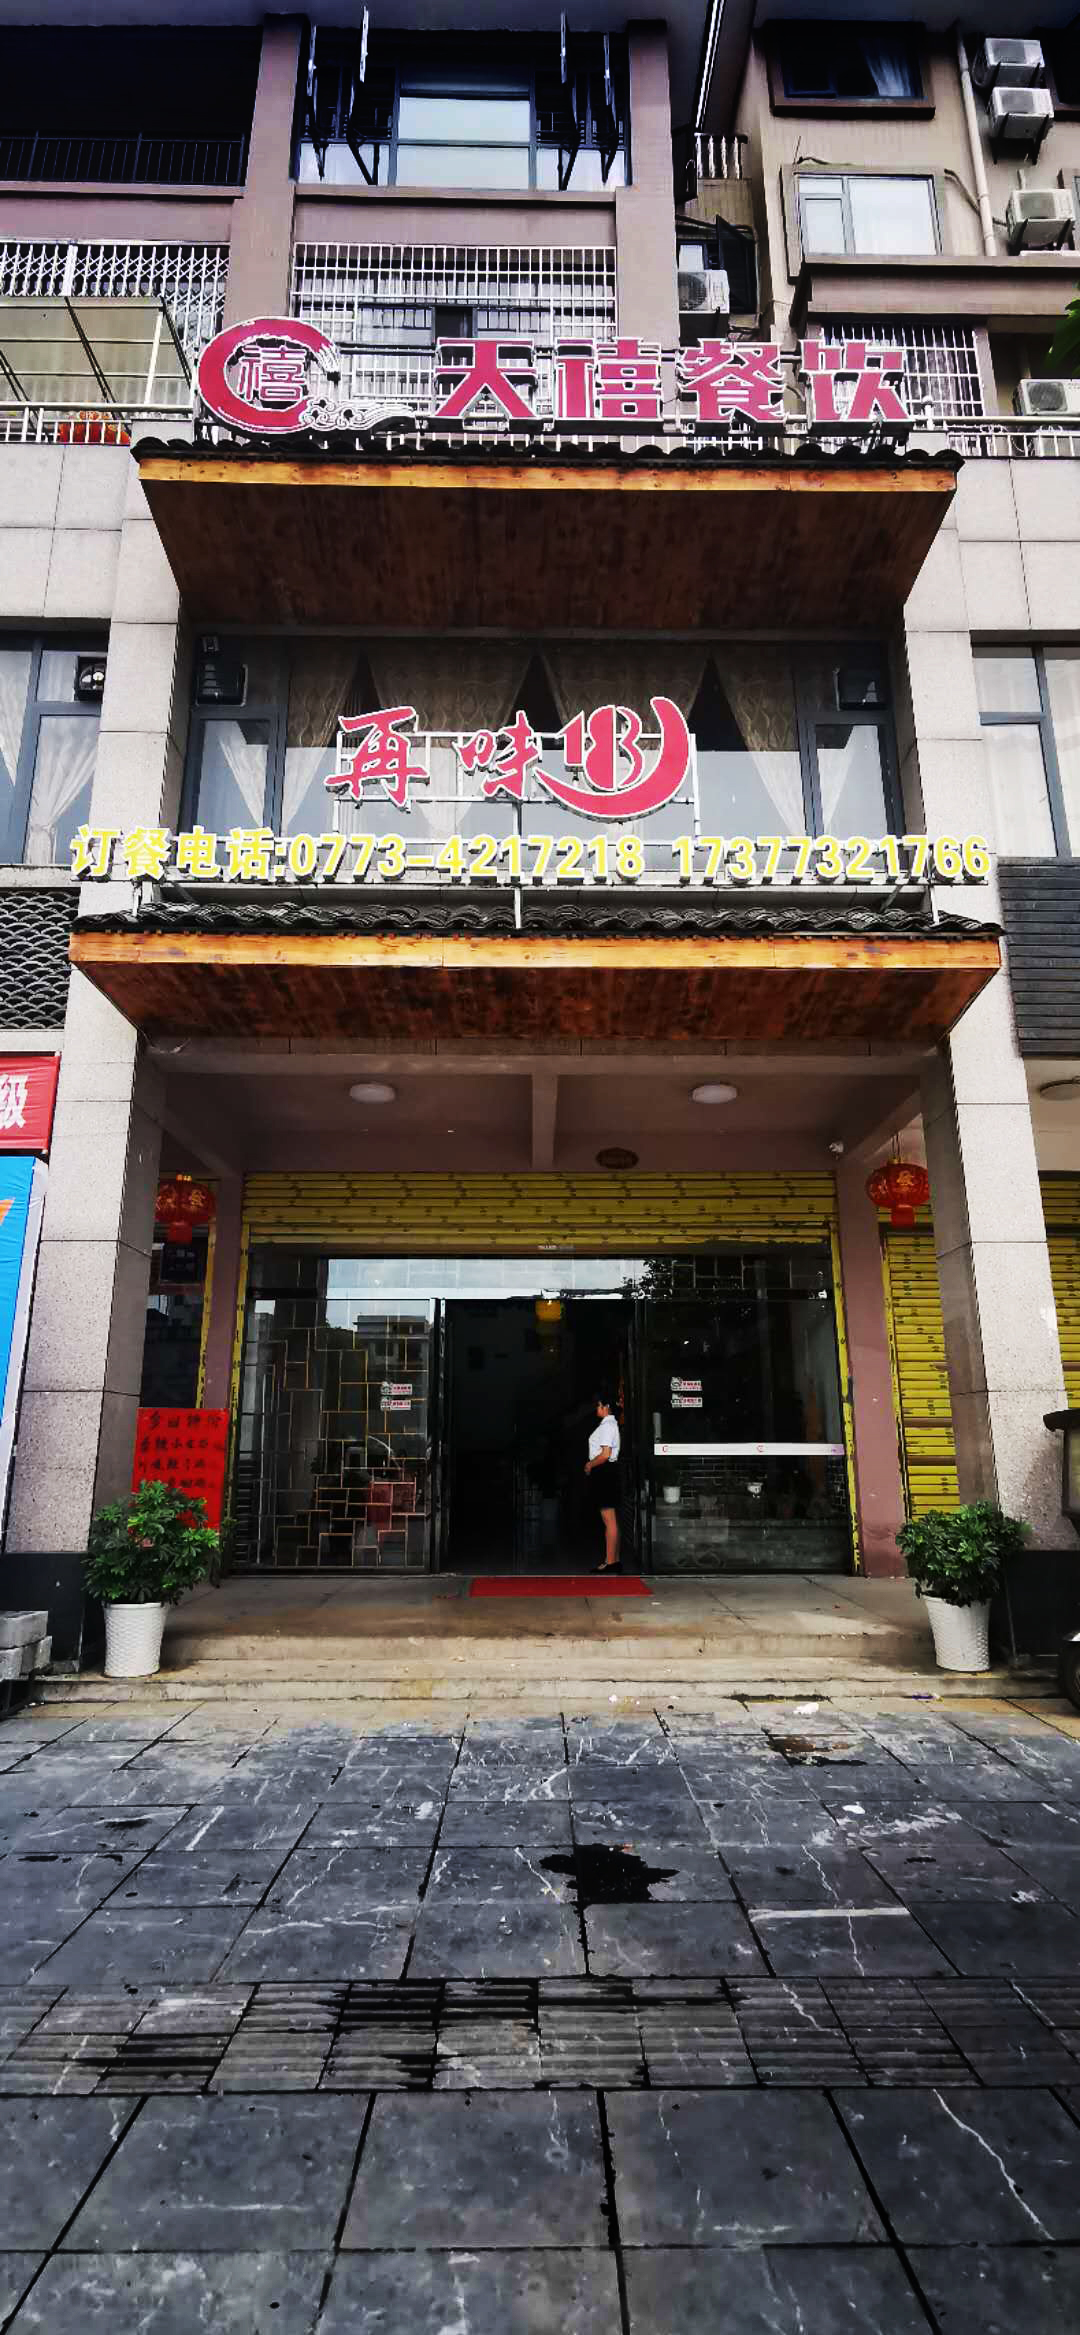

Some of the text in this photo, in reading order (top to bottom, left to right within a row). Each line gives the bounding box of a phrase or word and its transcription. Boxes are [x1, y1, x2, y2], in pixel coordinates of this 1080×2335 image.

[237, 345, 307, 401] 禧
[434, 337, 911, 422] 天禧餐饮
[324, 705, 539, 808] 再味
[69, 825, 991, 880] 订餐电话:0773-4217218 17377321766
